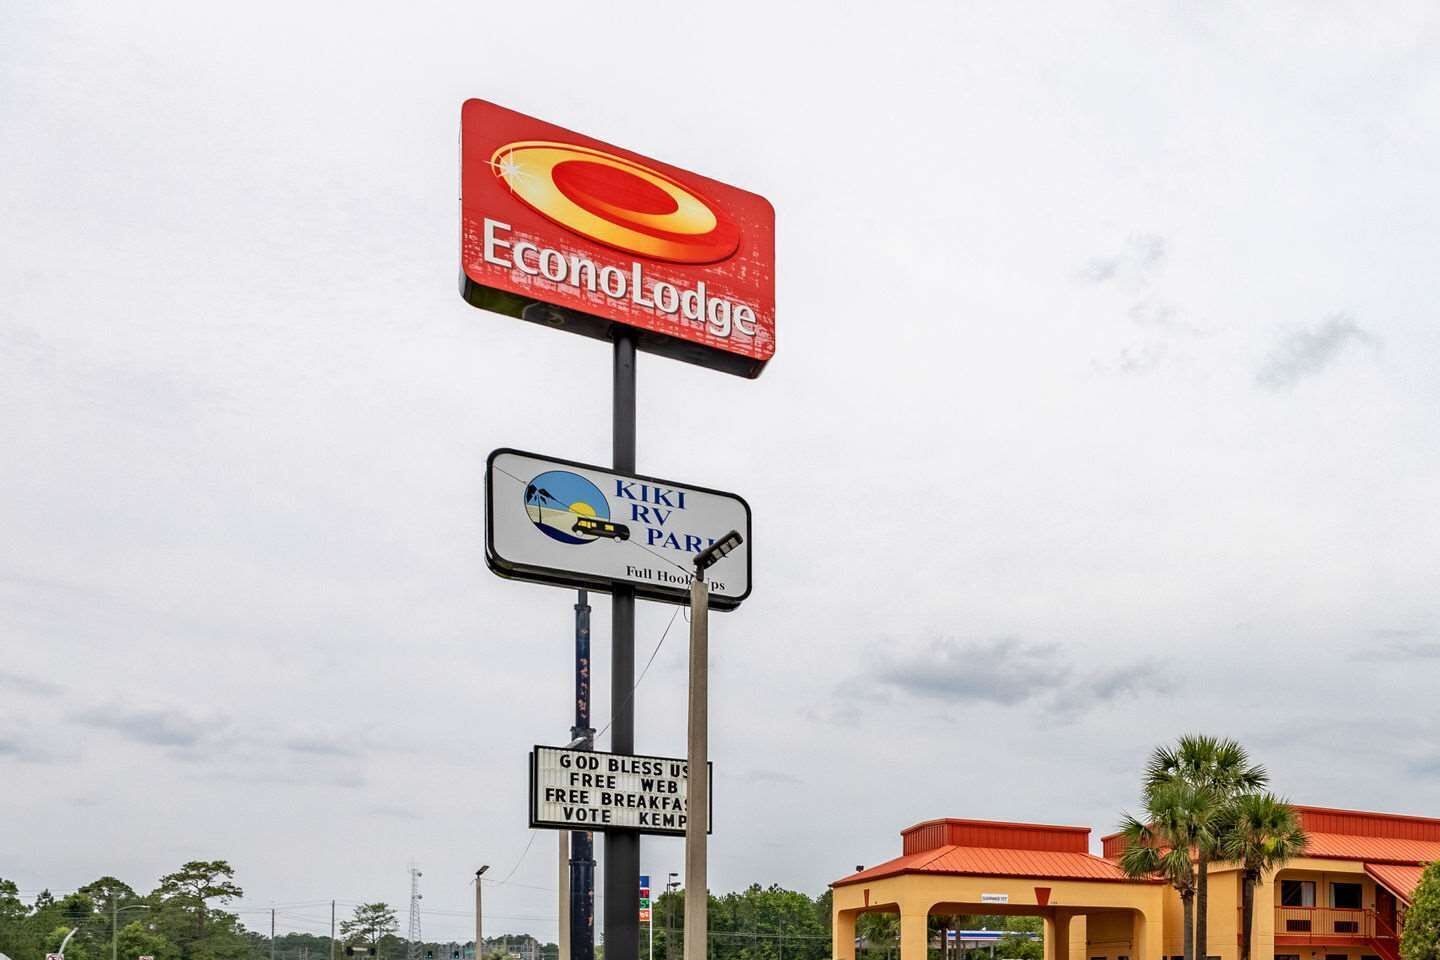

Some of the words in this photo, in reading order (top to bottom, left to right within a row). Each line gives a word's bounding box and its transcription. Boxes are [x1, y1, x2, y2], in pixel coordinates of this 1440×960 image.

[483, 217, 757, 337] EconoLodge
[614, 479, 687, 510] KIKI
[631, 504, 673, 527] RV
[647, 527, 717, 554] PAR
[626, 565, 652, 579] Full
[559, 753, 599, 770] GOD
[608, 758, 663, 776] BLESS
[570, 773, 616, 789] FREE
[640, 779, 678, 794] WEB
[545, 787, 589, 804] FREE
[601, 792, 688, 812] BREAKFA
[563, 806, 611, 823] VOTE
[639, 811, 687, 828] KEMP
